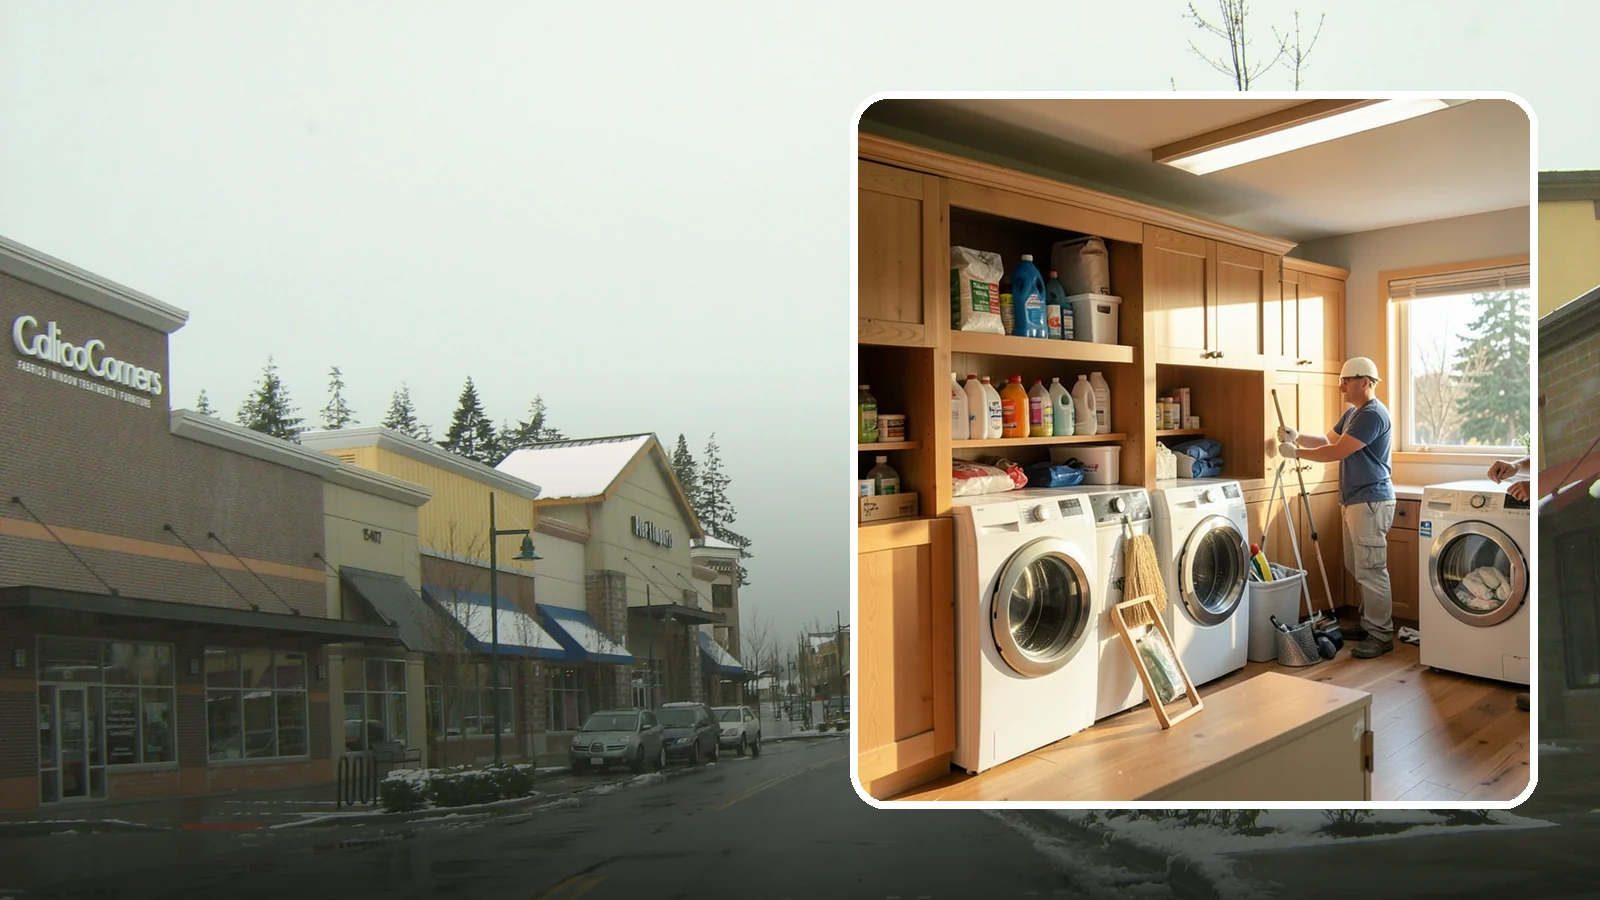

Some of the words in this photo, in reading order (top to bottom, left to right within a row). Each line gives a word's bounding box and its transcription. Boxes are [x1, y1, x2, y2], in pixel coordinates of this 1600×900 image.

[17, 360, 46, 377] FABRICS
[52, 370, 77, 386] WINDOW
[79, 378, 116, 398] TREATMENTS
